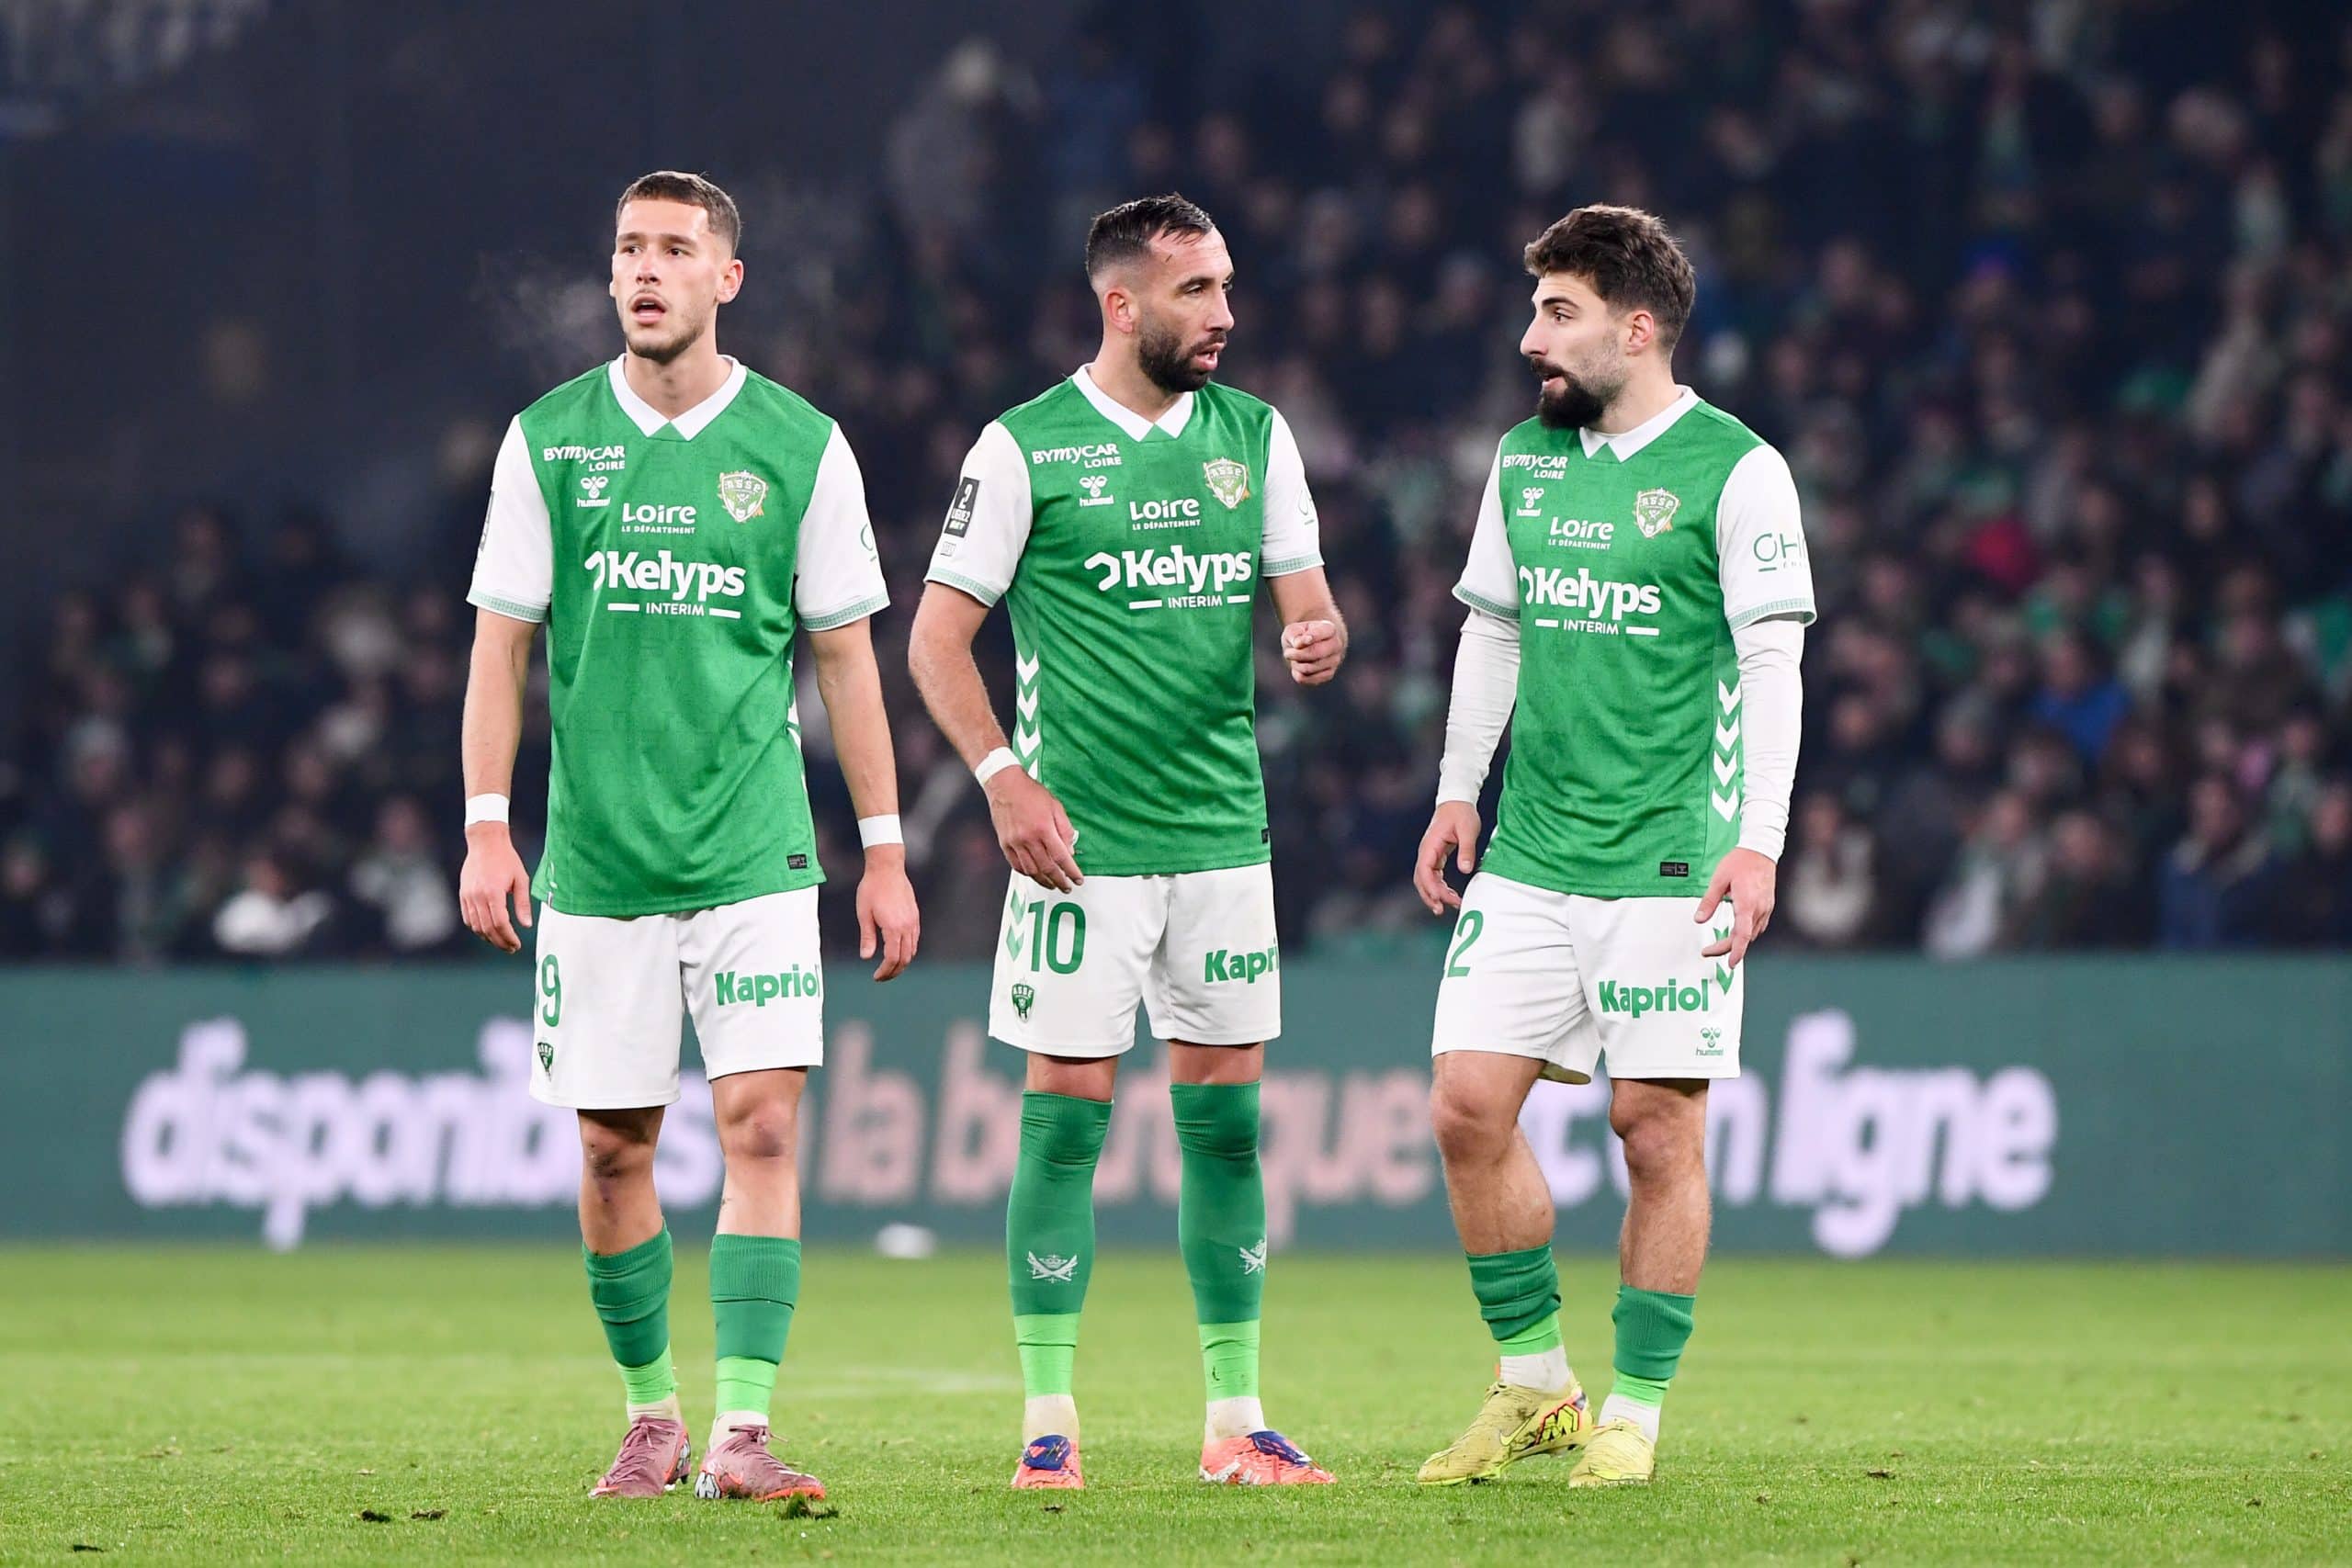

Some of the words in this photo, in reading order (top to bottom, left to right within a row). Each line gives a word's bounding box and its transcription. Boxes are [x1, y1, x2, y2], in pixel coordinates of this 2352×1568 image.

[589, 460, 626, 472] LOIRE
[1084, 457, 1123, 468] LOIRE
[1533, 469, 1566, 479] LOIRE
[958, 483, 973, 509] 2
[622, 502, 696, 525] Loire
[1129, 497, 1200, 521] Loire
[633, 525, 695, 534] DÉPARTEMENT
[1132, 523, 1141, 531] LE
[1144, 518, 1201, 530] DÉPARTEMENT
[1550, 516, 1614, 540] Loire
[1558, 538, 1611, 550] DÉPARTEMENT
[607, 549, 746, 602] Kelyps
[1122, 545, 1252, 593] Kelyps
[1168, 595, 1223, 608] INTERIM
[1534, 567, 1661, 620] Kelyps
[646, 602, 705, 616] INTERIM
[1563, 618, 1619, 635] INTERIM
[1028, 899, 1086, 975] 10
[1447, 909, 1484, 978] 2
[1204, 936, 1279, 984] Kapri
[537, 954, 561, 1027] 9
[1599, 978, 1708, 1018] Kapriol
[1773, 1008, 2059, 1258] ligne
